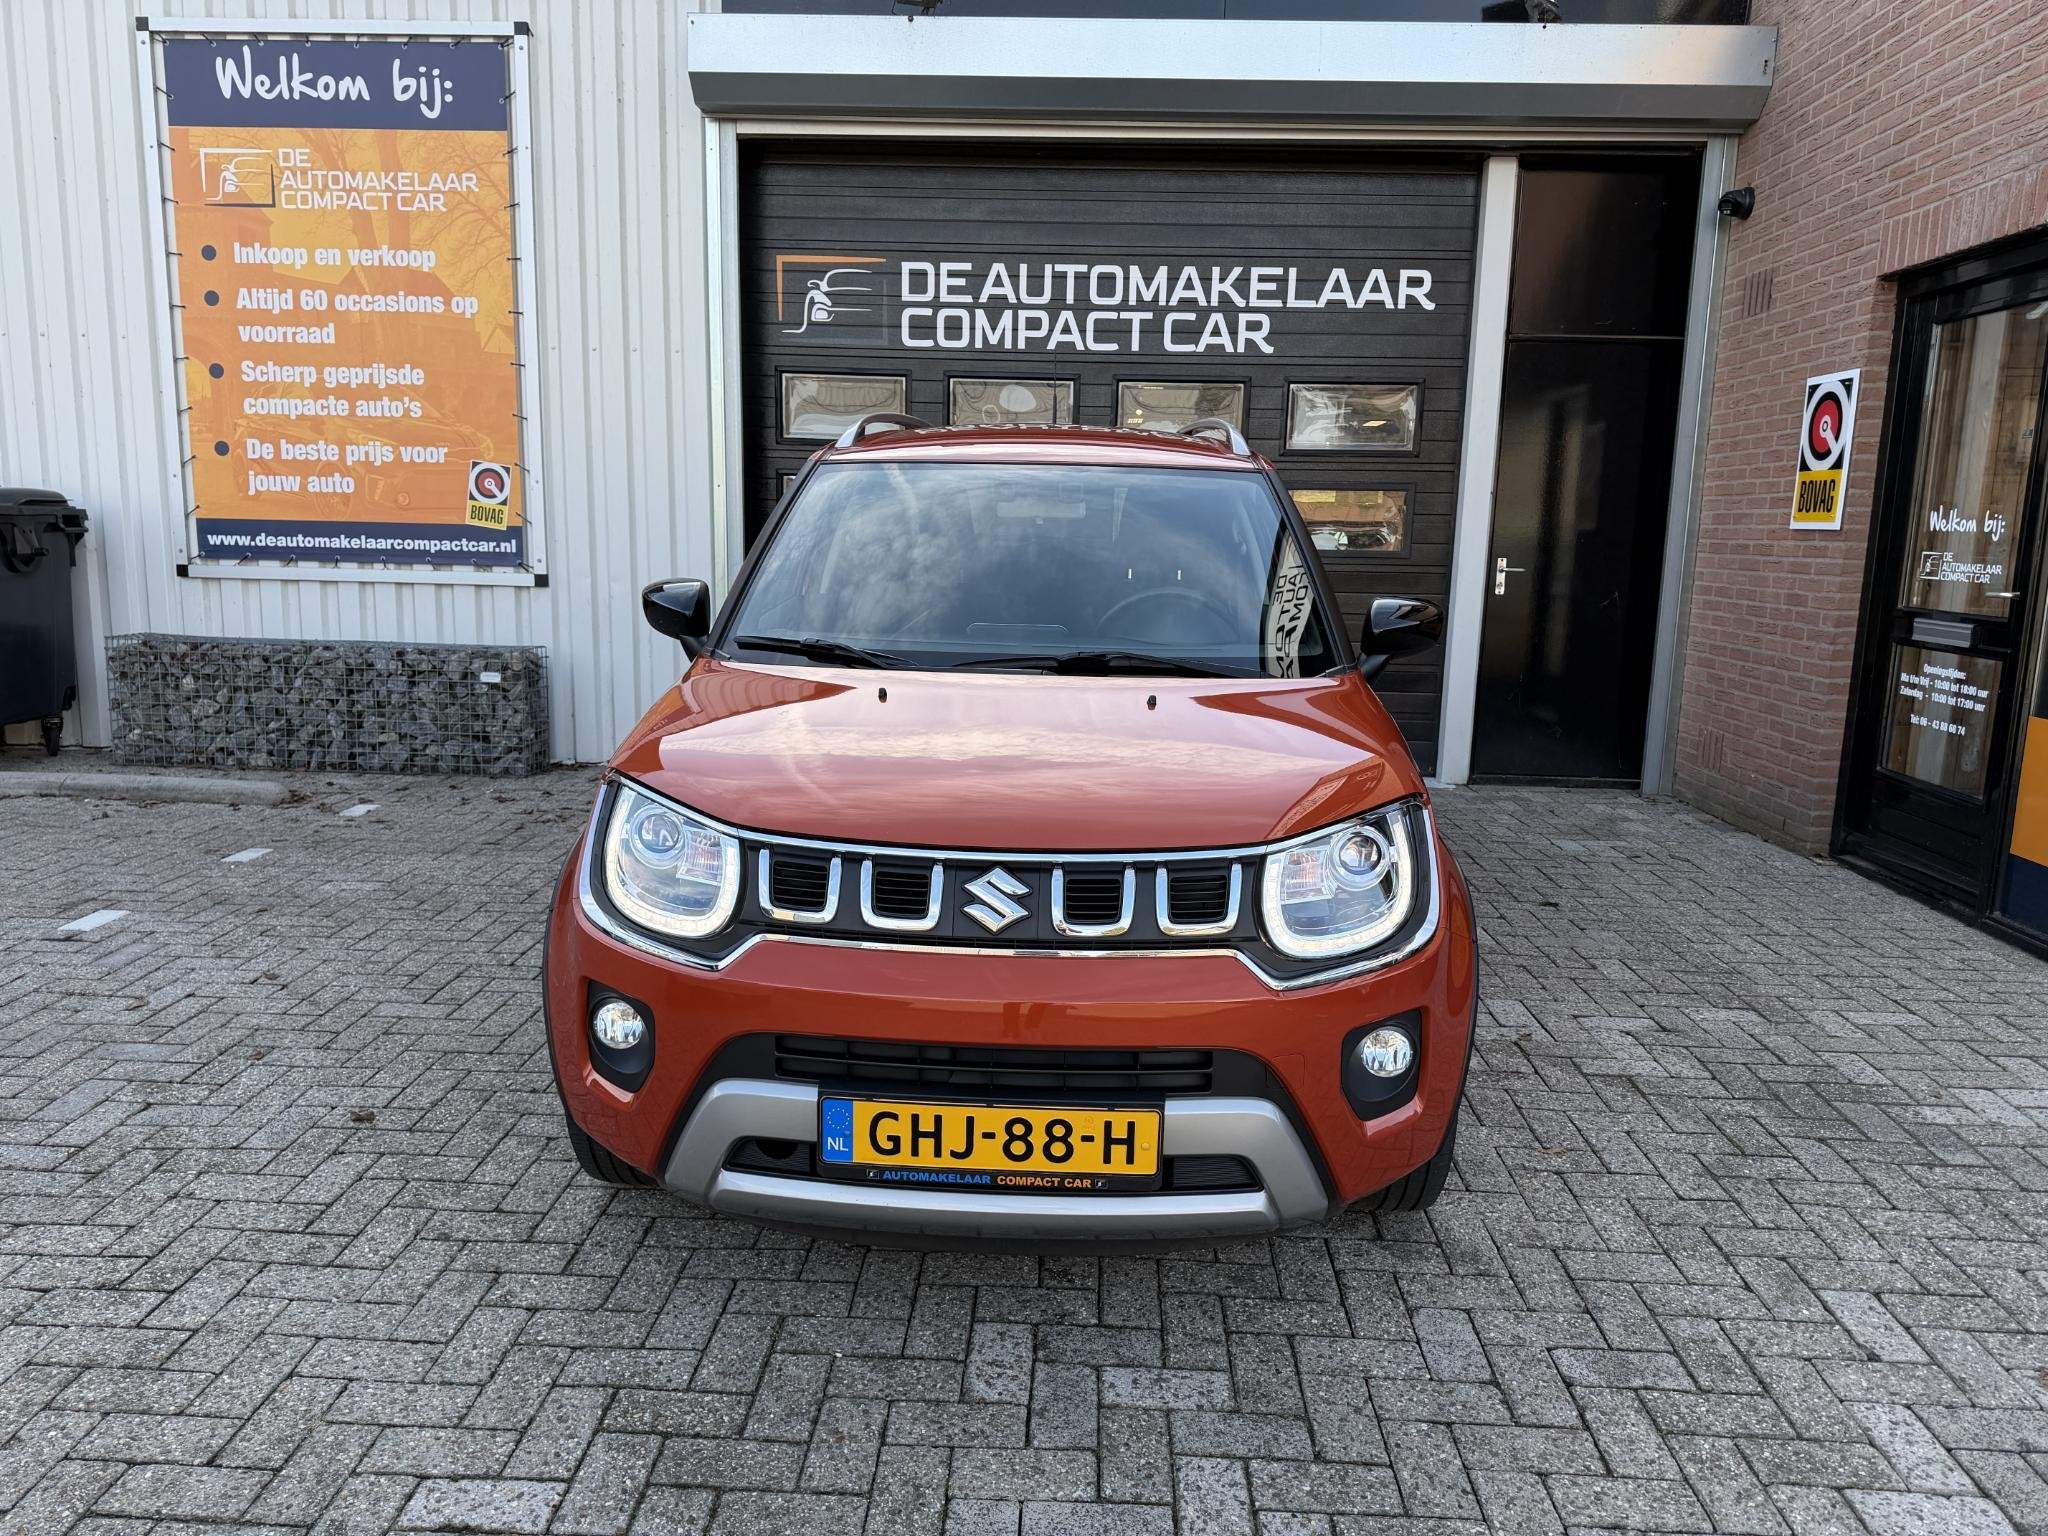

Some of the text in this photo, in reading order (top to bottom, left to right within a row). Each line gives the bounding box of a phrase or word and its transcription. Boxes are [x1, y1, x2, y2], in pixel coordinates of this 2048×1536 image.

[215, 45, 453, 118] Welkom bij:
[279, 149, 311, 167] DE
[280, 170, 479, 192] AUTOMAKELAAR
[281, 191, 446, 212] COMPACT CAR
[233, 242, 436, 271] Inkoop en verkoop
[901, 261, 1435, 311] DE AUTOMAKELAAR
[237, 288, 478, 318] Altijd 60 occasions op
[238, 323, 335, 344] voorraad
[901, 307, 1274, 354] COMPACT CAR
[241, 360, 425, 389] Scherp geprijsde
[243, 396, 422, 419] compacte auto's
[246, 438, 448, 466] De beste prijs voor
[248, 470, 355, 495] jouw auto
[1798, 479, 1836, 513] BOVAG
[470, 504, 504, 525] BOVAG
[1929, 505, 2005, 541] Welkom bij:
[207, 532, 516, 555] www.deautomakelaarcompactcar.nl
[1942, 562, 2002, 574] AUTOMAKELAAR
[1943, 552, 1953, 561] DE
[1940, 572, 1990, 584] COMPACT CAR
[827, 1110, 1135, 1165] NL GHJ-88-H
[883, 1170, 1092, 1189] AUTOMAKELAAR COMPACT CAR
